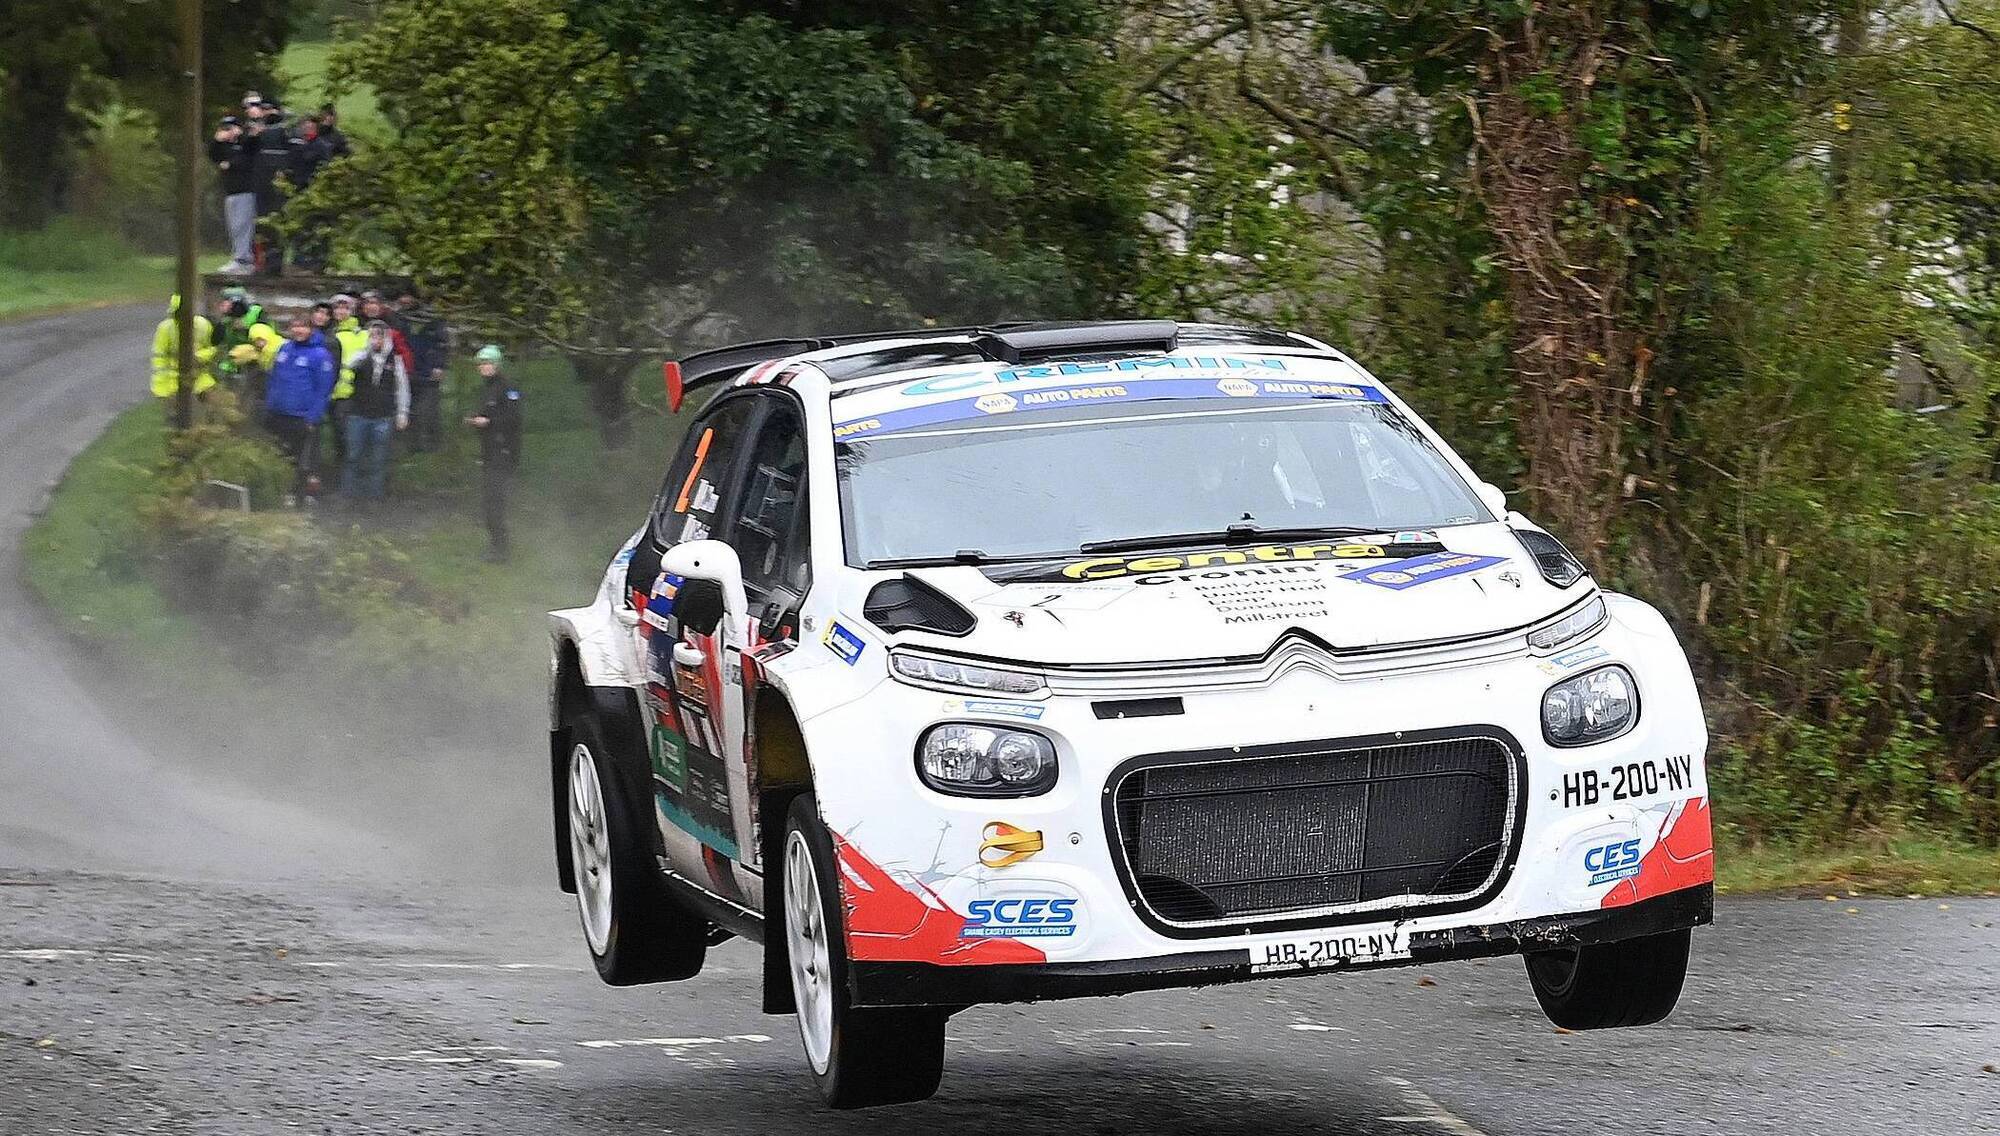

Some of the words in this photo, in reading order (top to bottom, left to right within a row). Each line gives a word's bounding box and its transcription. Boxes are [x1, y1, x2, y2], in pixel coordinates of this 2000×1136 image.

[901, 357, 1287, 395] CREMIN
[1023, 390, 1070, 404] AUTO
[1070, 385, 1128, 399] PARTS
[1264, 382, 1309, 393] AUTO
[1309, 384, 1365, 397] PARTS
[1061, 545, 1385, 579] Centra
[1133, 562, 1358, 585] Cronin's
[1202, 589, 1272, 598] Union
[1279, 584, 1326, 592] Hall
[1208, 596, 1265, 605] Leap
[1216, 600, 1324, 612] Dundrum
[1225, 610, 1328, 624] Millstreet
[1563, 754, 1692, 808] HB-200-NY
[1585, 838, 1641, 871] CES
[964, 898, 1078, 925] SCES
